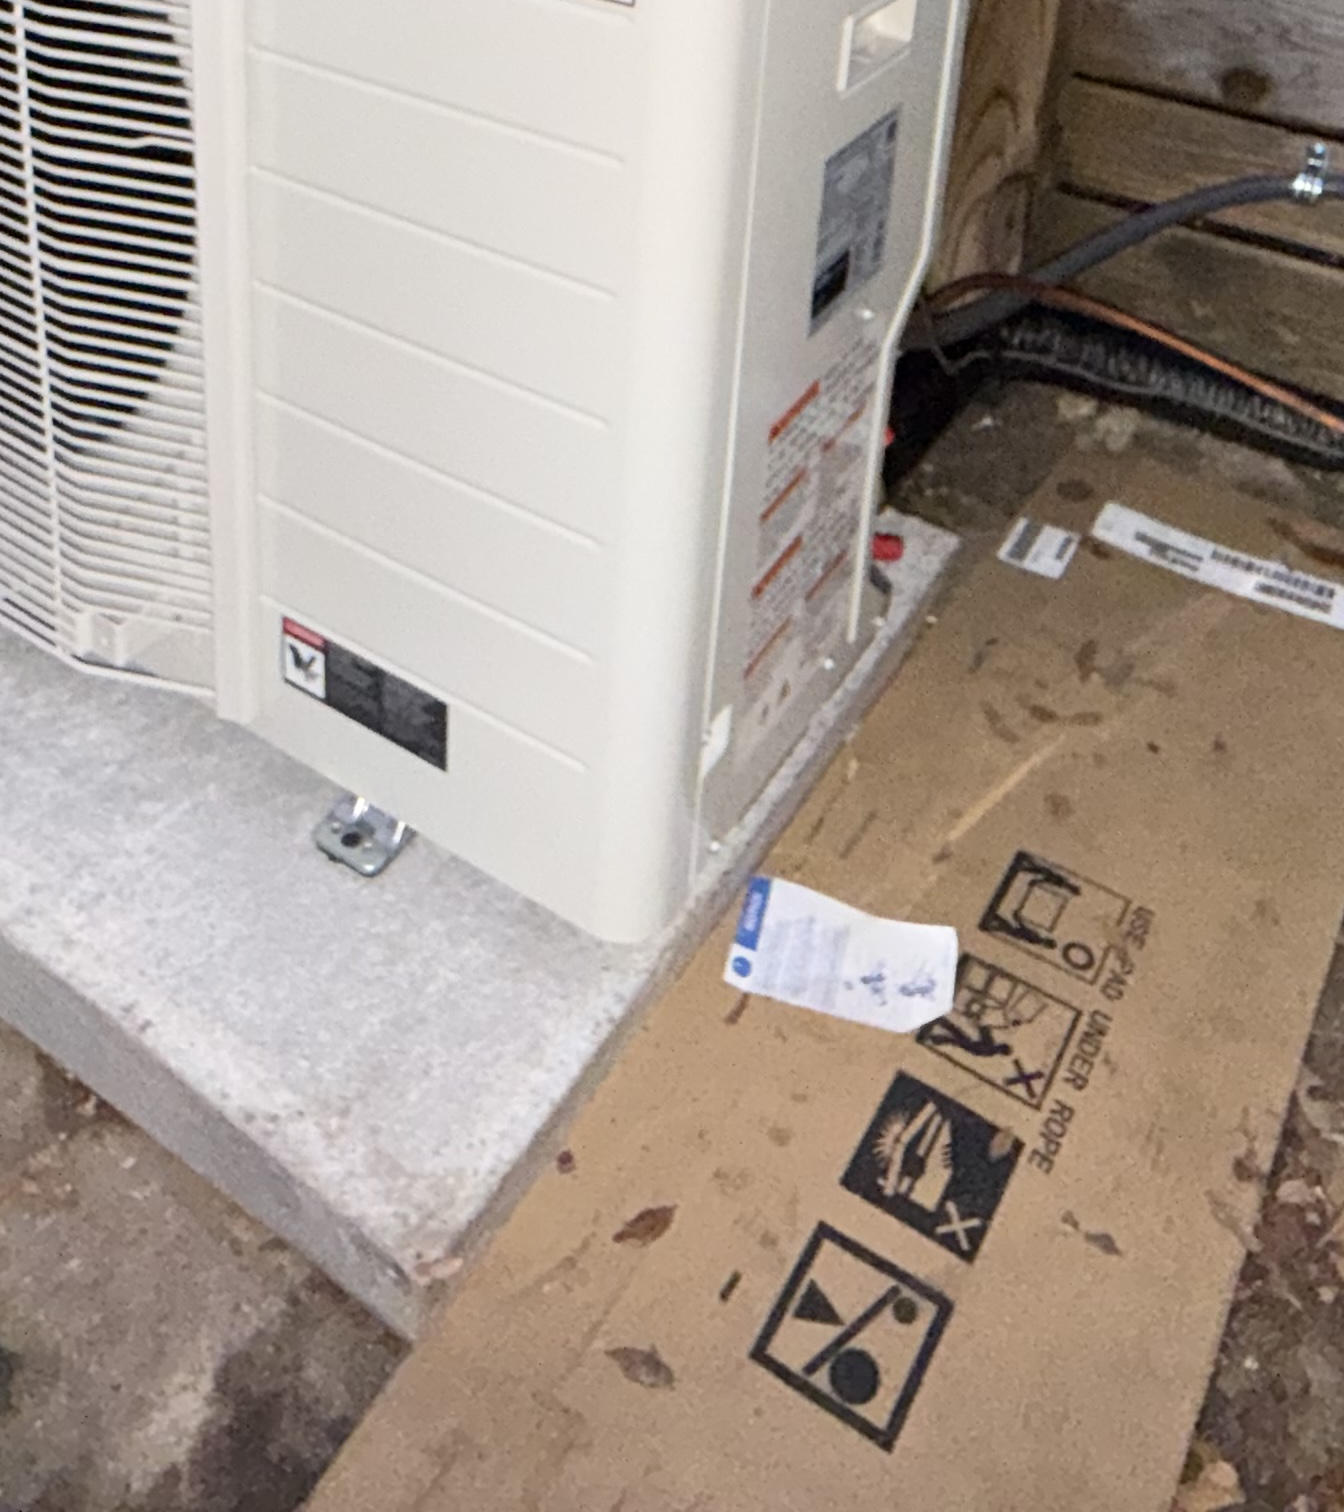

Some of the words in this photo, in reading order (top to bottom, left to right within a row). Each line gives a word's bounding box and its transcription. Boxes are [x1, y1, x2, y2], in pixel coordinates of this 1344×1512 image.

[1124, 905, 1155, 951] USE
[1062, 1009, 1113, 1092] UNDER
[1027, 1098, 1076, 1176] ROPE
